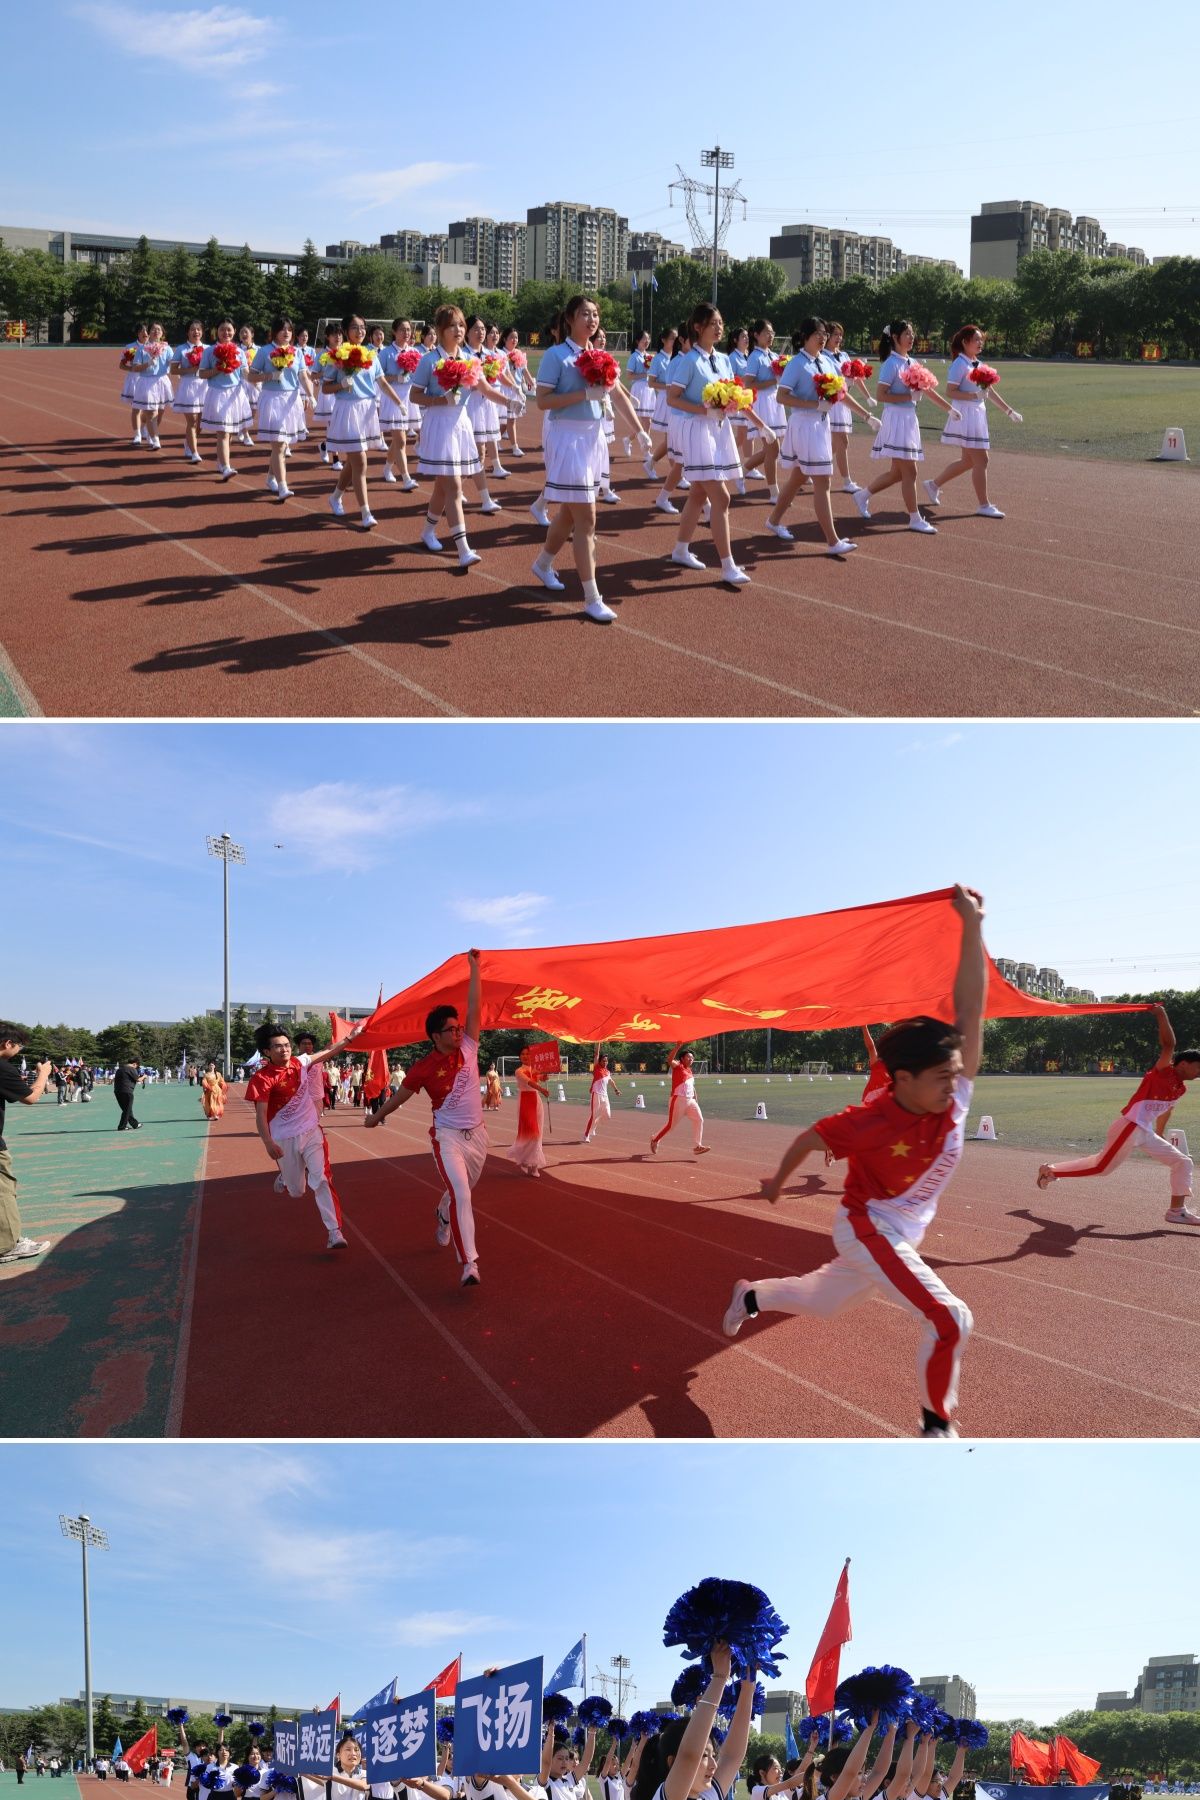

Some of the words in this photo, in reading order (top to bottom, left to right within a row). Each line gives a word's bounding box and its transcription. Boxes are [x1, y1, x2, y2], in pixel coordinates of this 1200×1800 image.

[7, 322, 24, 337] 运
[1168, 438, 1177, 448] 11
[757, 1105, 762, 1115] 8
[983, 1124, 989, 1132] 10
[1170, 1137, 1178, 1147] 11
[461, 1682, 533, 1752] 飞扬
[371, 1705, 429, 1765] 逐梦
[300, 1724, 331, 1762] 致远
